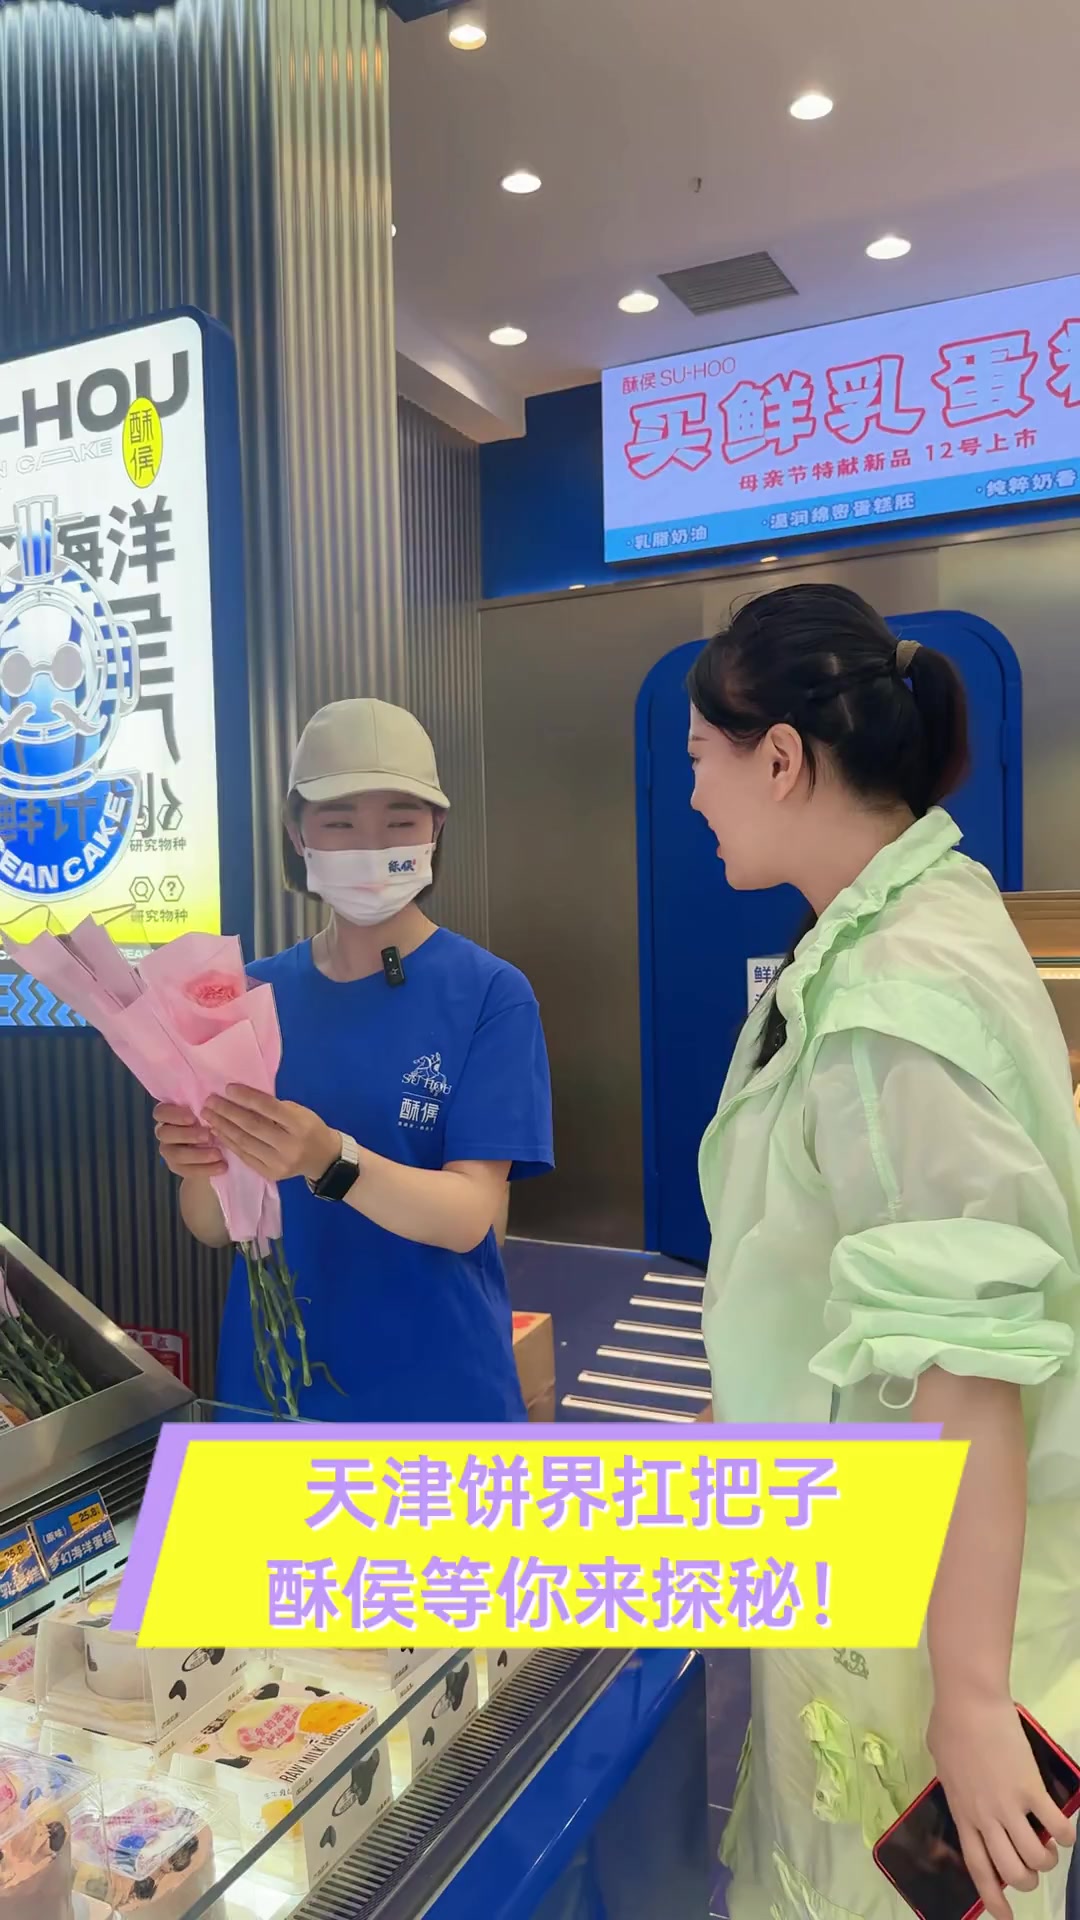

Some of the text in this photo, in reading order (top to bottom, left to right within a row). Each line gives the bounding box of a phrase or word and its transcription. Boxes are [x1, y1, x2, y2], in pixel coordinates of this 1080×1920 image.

[740, 428, 1037, 492] 母亲节特献新品 12号上市
[633, 525, 708, 550] 乳脂奶油
[985, 468, 1078, 498] 纯粹奶香
[62, 792, 127, 883] CAKE
[129, 836, 187, 853] 研究物种
[130, 908, 189, 925] 研究物种
[48, 1529, 115, 1572] 梦幻海洋蛋糕
[279, 1763, 307, 1783] RAW
[302, 1744, 329, 1766] MILK
